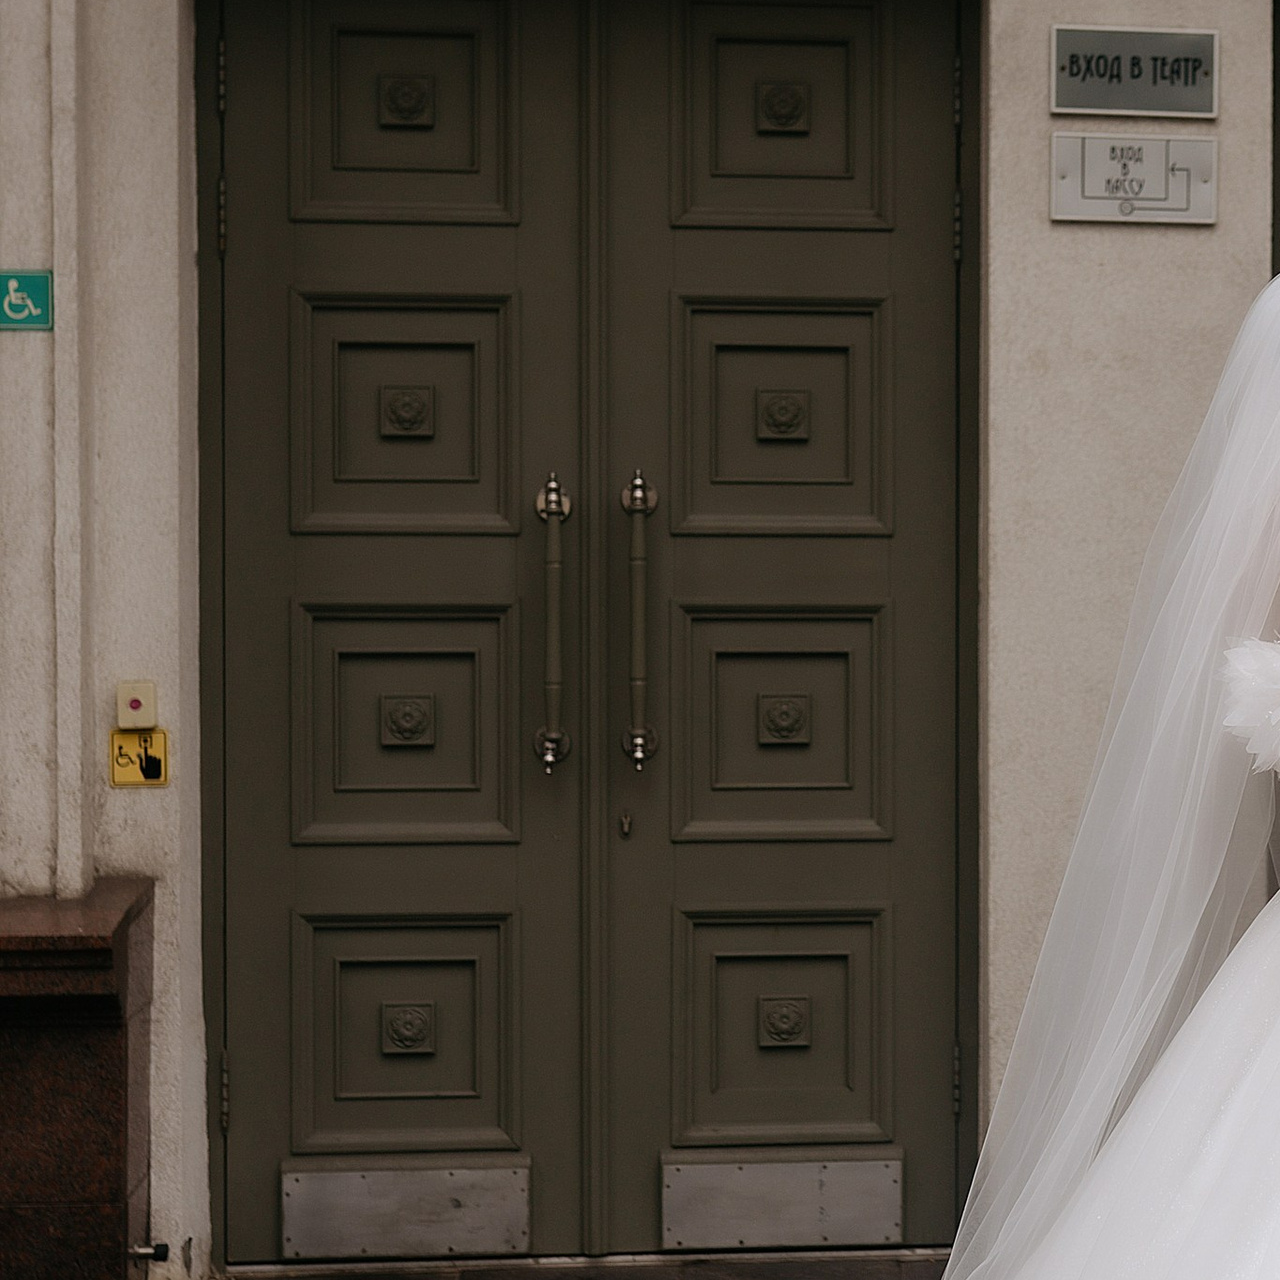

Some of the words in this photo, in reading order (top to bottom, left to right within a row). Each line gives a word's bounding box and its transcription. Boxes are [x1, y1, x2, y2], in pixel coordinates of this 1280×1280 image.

[1068, 53, 1122, 84] ВХОД
[1130, 55, 1144, 80] В
[1151, 56, 1203, 87] ТЕАТР
[1109, 145, 1144, 164] ВХОД
[1104, 178, 1146, 197] КАССУ
